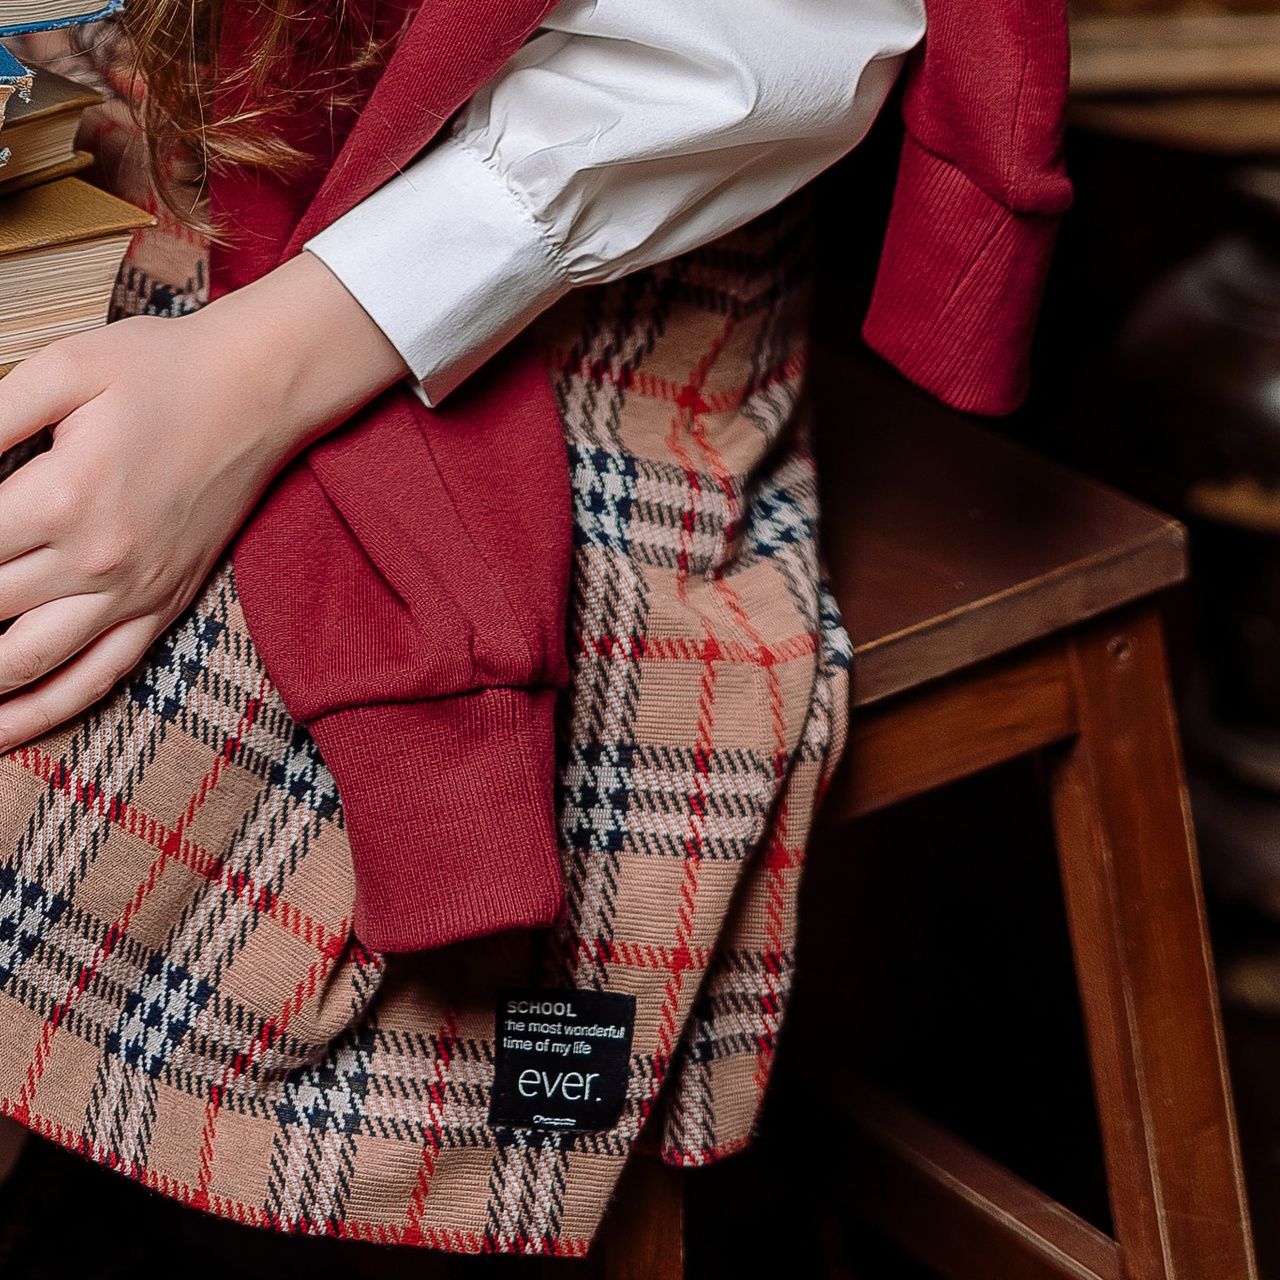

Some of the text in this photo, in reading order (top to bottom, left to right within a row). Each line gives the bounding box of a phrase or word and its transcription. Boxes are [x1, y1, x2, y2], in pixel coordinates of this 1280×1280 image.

[507, 1000, 577, 1018] SCHOOL
[528, 1022, 562, 1035] most
[503, 1036, 592, 1057] time of my life
[518, 1068, 602, 1102] ever.
